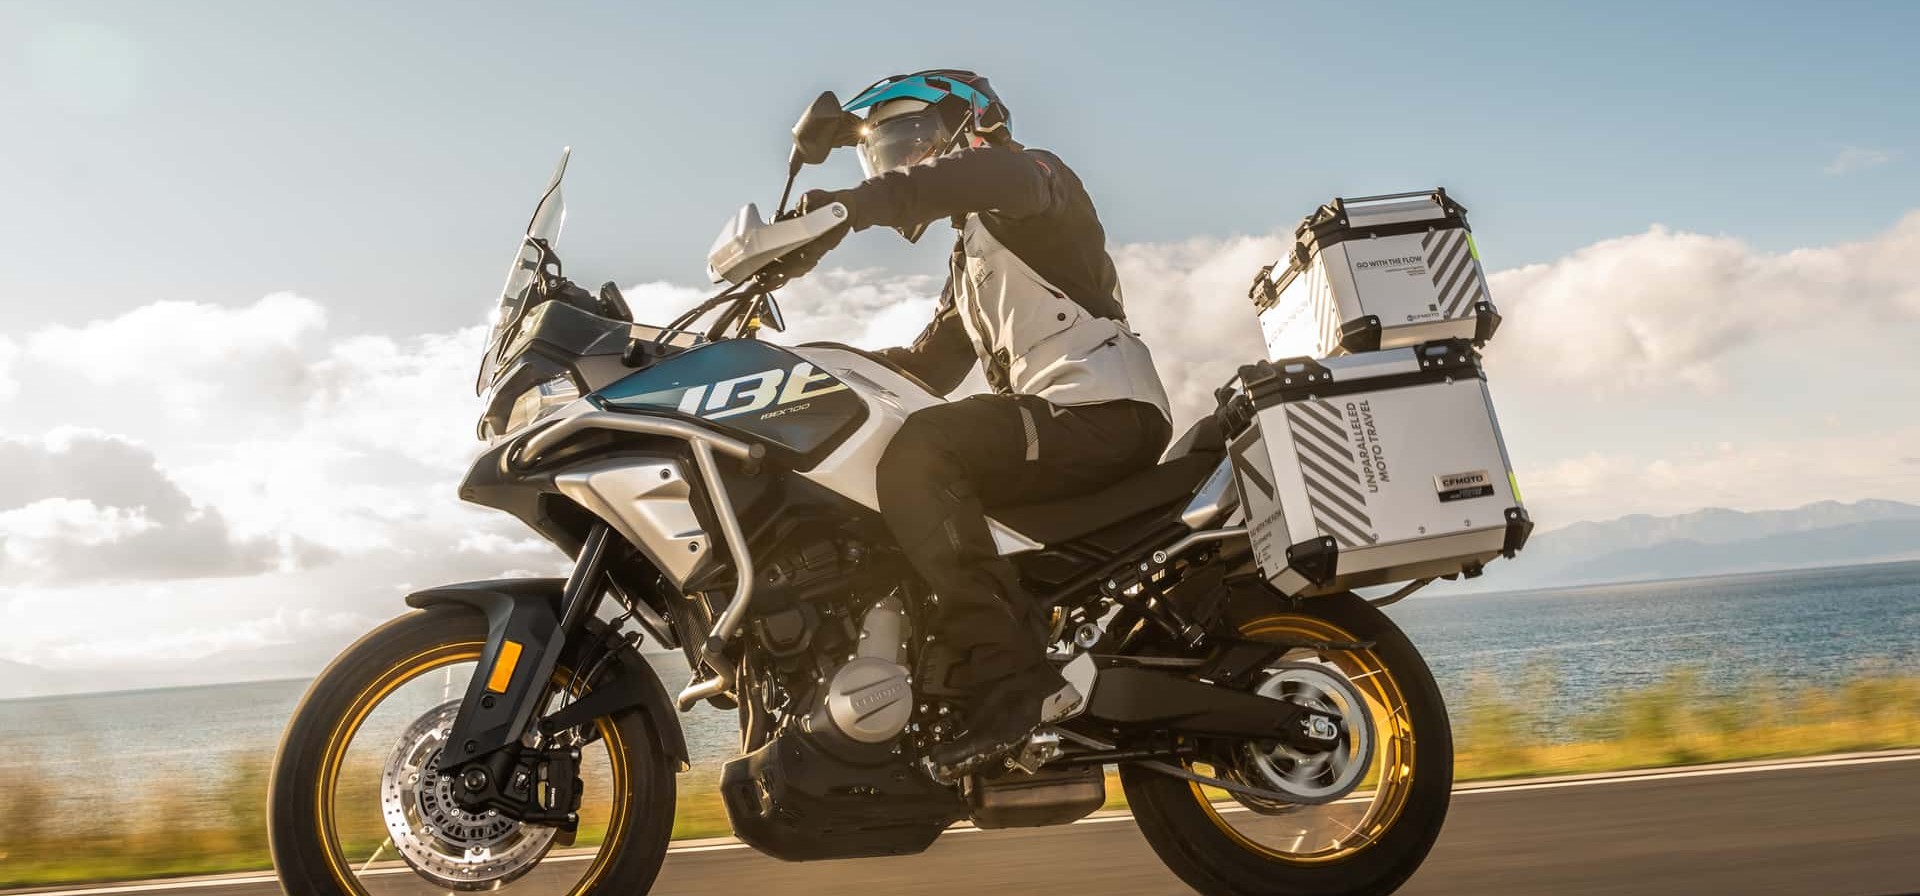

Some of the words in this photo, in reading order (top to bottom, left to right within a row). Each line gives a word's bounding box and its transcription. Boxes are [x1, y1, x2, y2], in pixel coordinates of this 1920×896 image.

[1369, 259, 1388, 267] WITH
[1388, 258, 1401, 266] THE
[1402, 255, 1422, 264] FLOW
[1360, 400, 1379, 442] TRAVEL
[1346, 402, 1378, 493] UNPARALLELED
[1371, 444, 1390, 482] MOTO
[1442, 475, 1484, 487] CFMOTO
